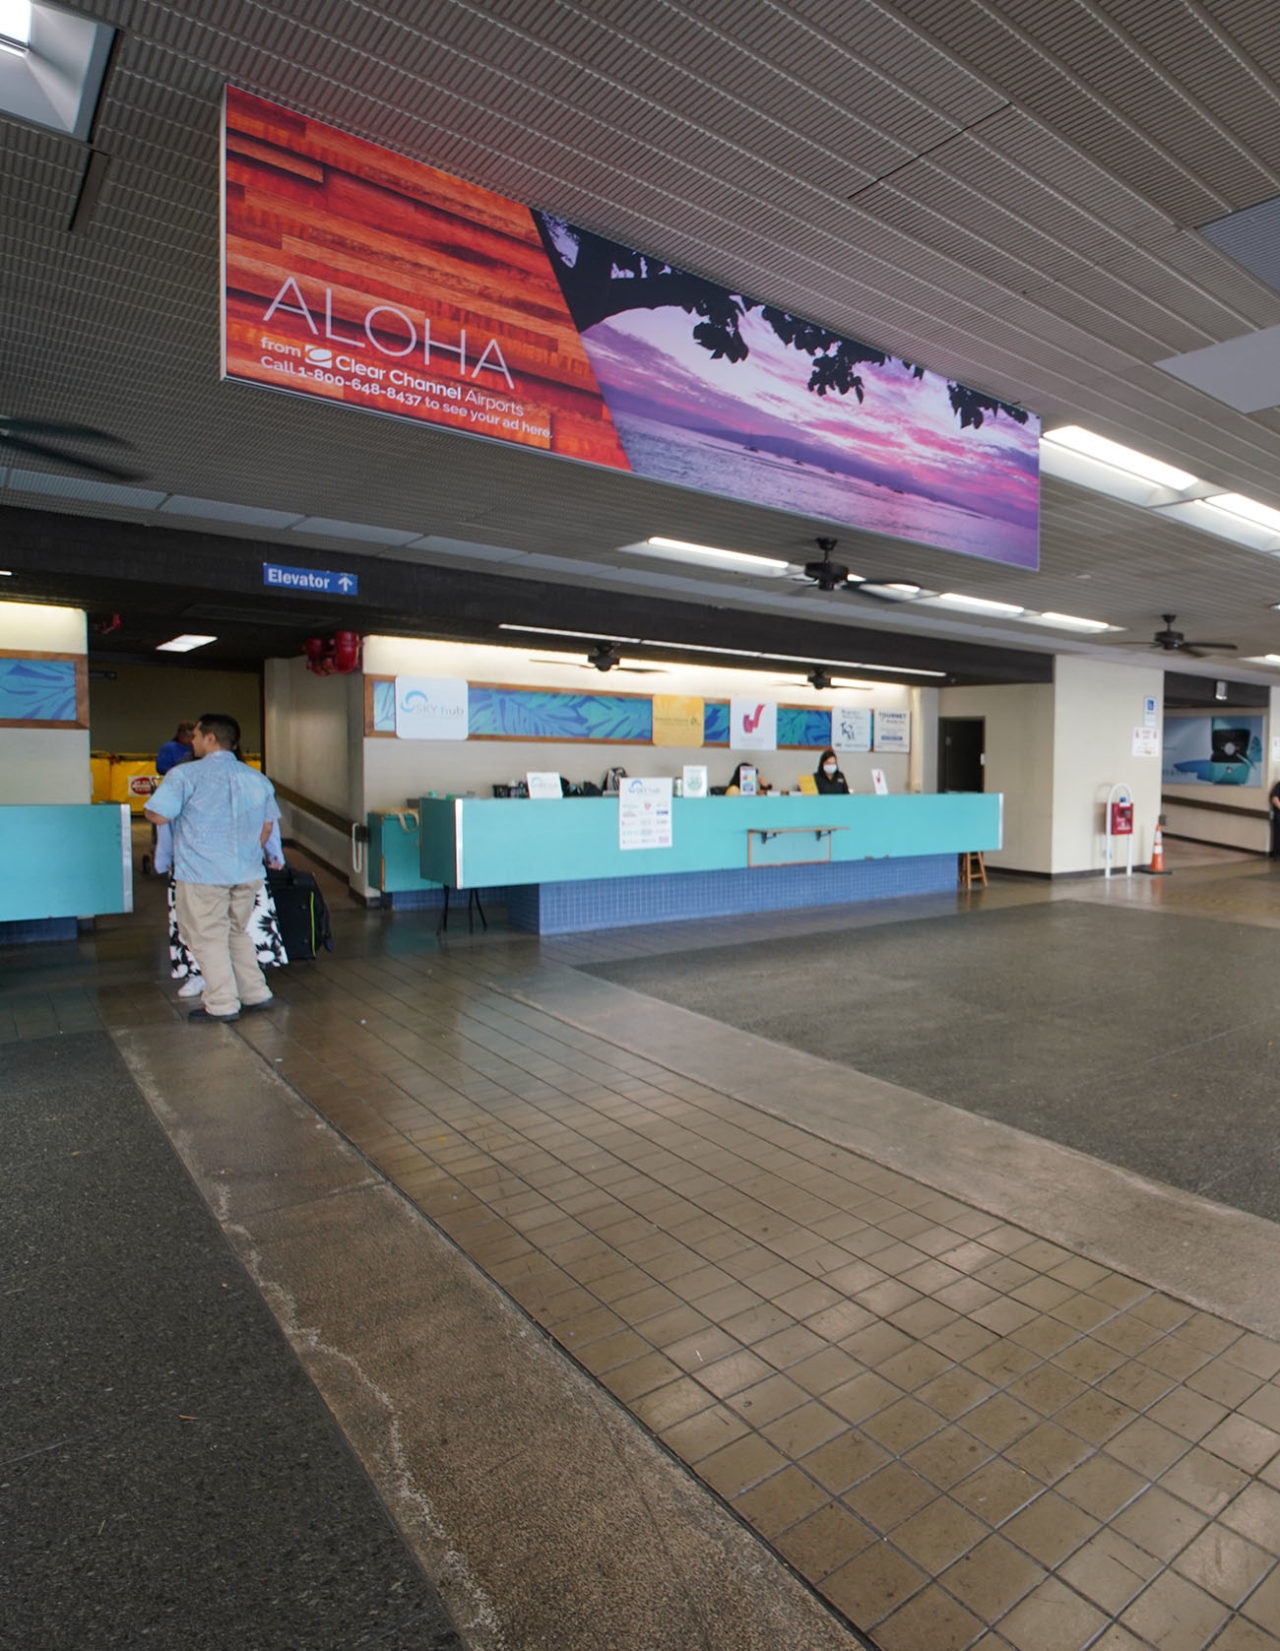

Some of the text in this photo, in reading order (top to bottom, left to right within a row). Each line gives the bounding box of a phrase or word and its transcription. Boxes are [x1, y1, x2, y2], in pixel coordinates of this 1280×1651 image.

[263, 276, 515, 390] ALOHA
[260, 355, 553, 439] Call 1-800-648-8437 to see your ad here.
[261, 336, 525, 417] from Clear Channel Airports
[267, 568, 331, 590] Elevator
